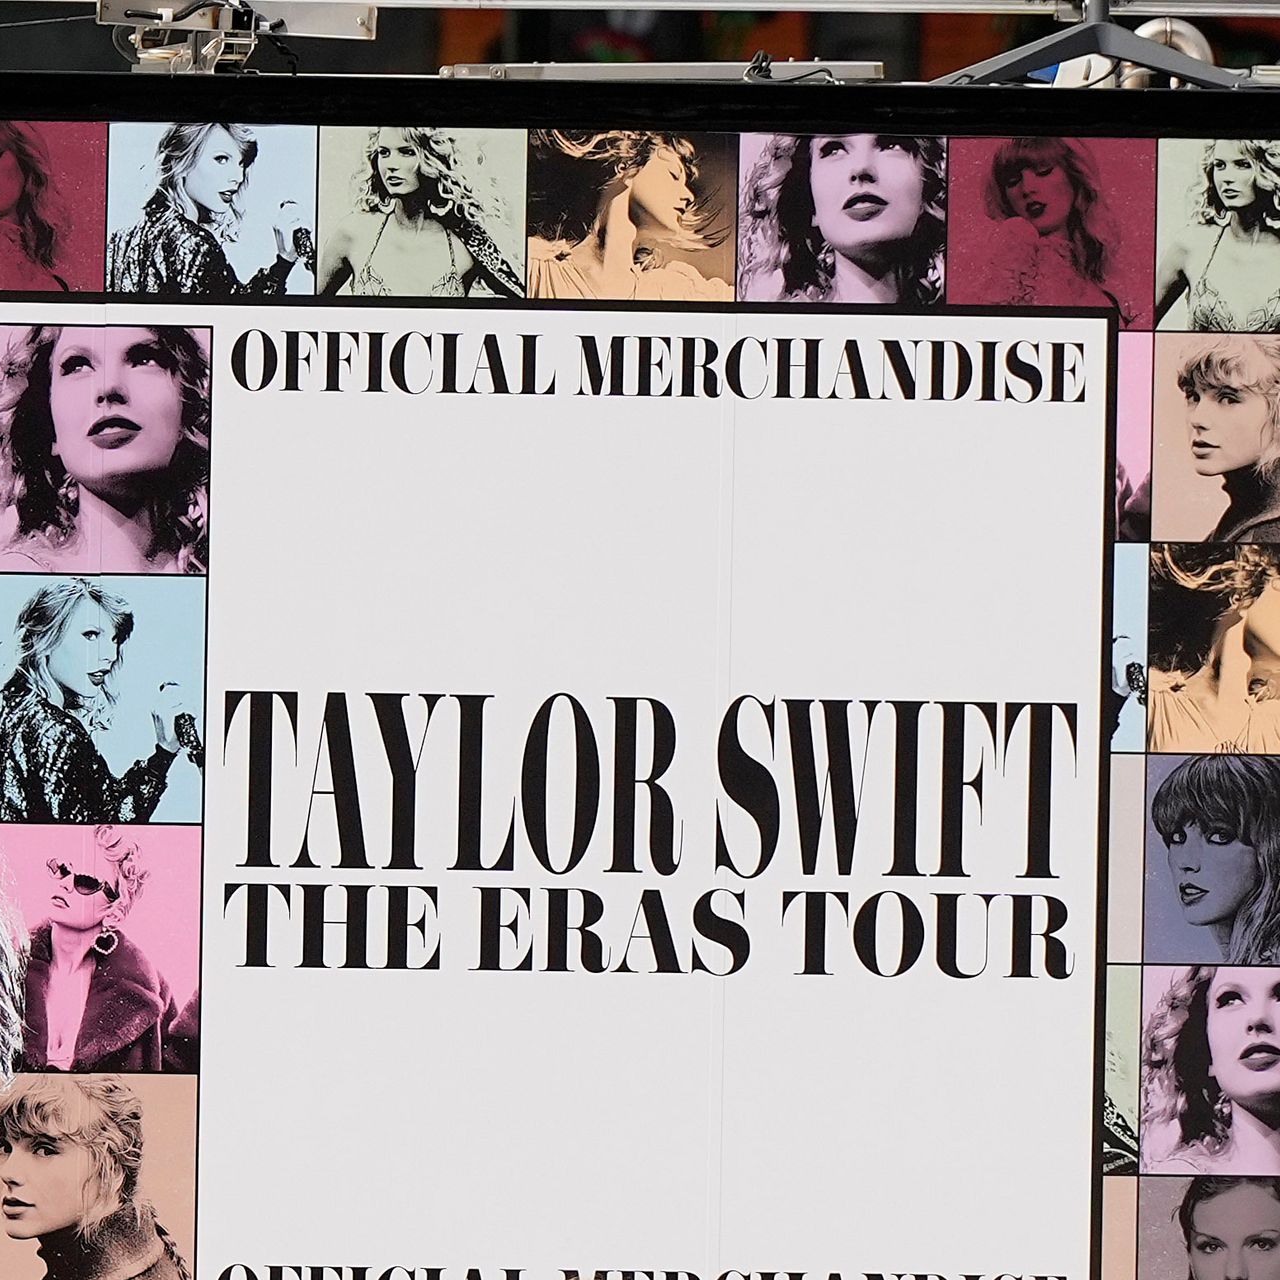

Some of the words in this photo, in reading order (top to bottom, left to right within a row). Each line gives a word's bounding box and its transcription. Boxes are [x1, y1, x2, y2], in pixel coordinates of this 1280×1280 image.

[230, 328, 556, 396] OFFICIAL
[576, 335, 1086, 404] MERCHANDISE
[223, 690, 683, 878] TAYLOR
[714, 694, 1078, 881] SWIFT
[223, 883, 441, 970] THE
[467, 886, 751, 978] ERAS
[781, 890, 1074, 981] TOUR
